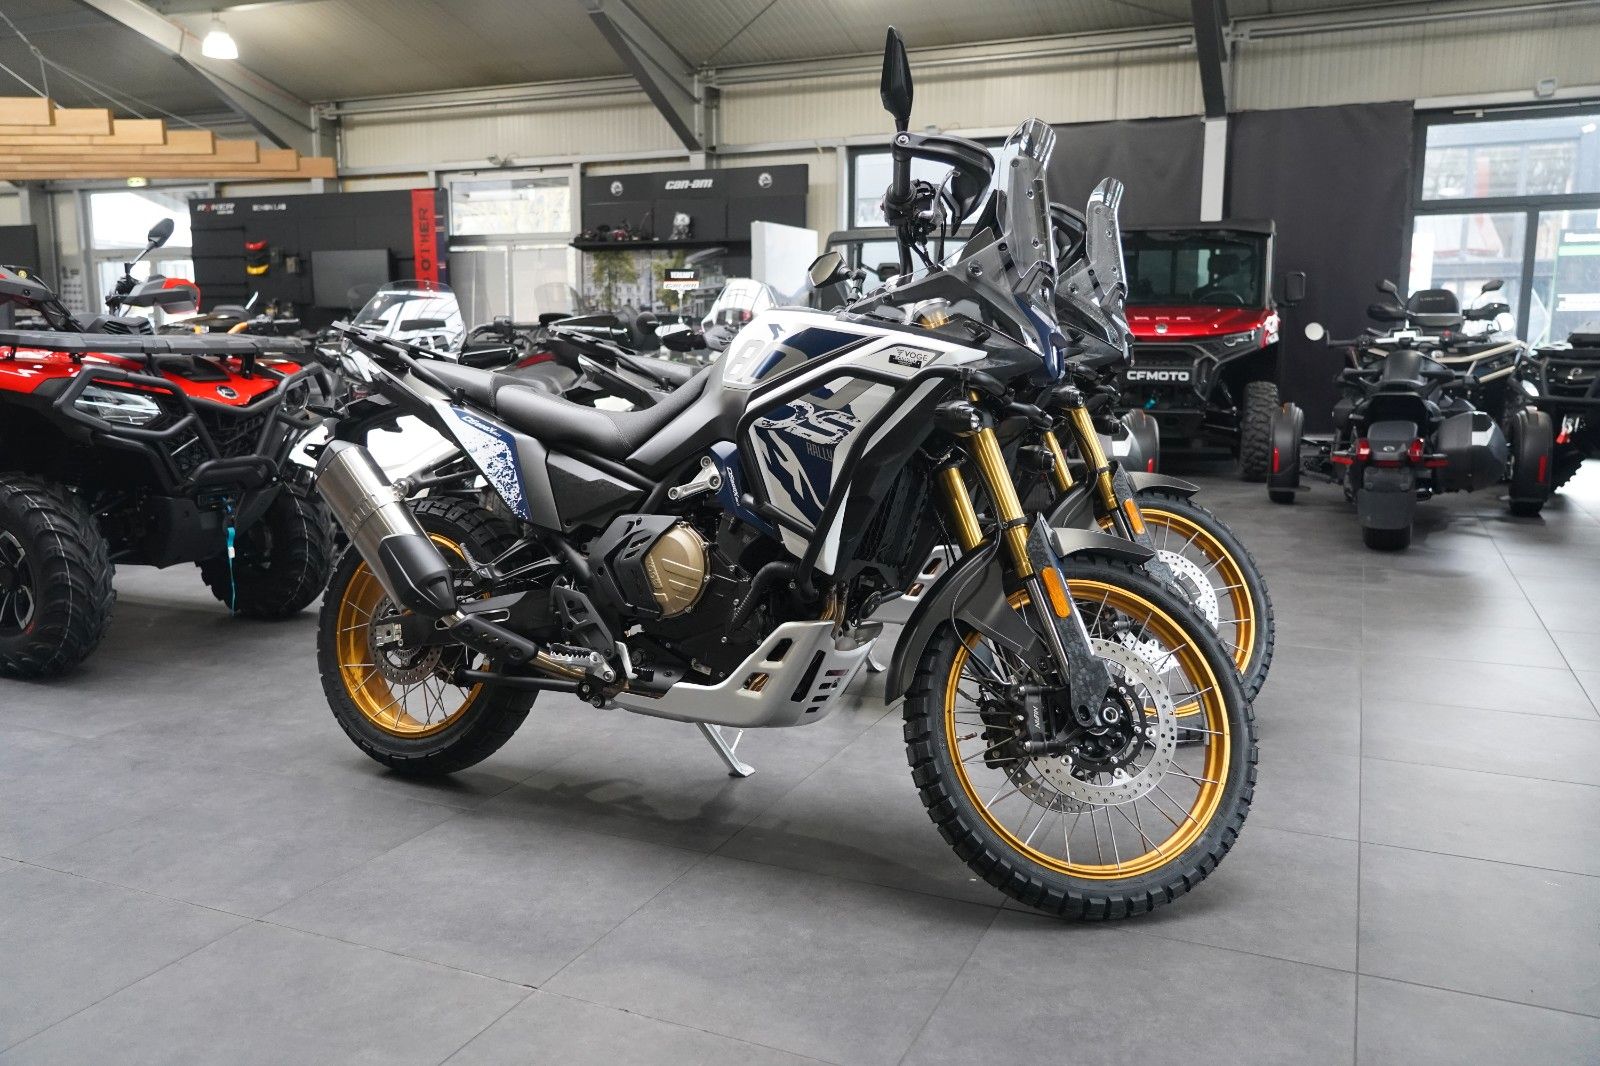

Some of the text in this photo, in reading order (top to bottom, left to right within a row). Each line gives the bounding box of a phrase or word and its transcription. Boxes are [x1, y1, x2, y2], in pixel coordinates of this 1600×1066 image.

[905, 350, 929, 363] VOGE
[1127, 371, 1189, 381] CFMOTO
[806, 442, 834, 462] RALLY
